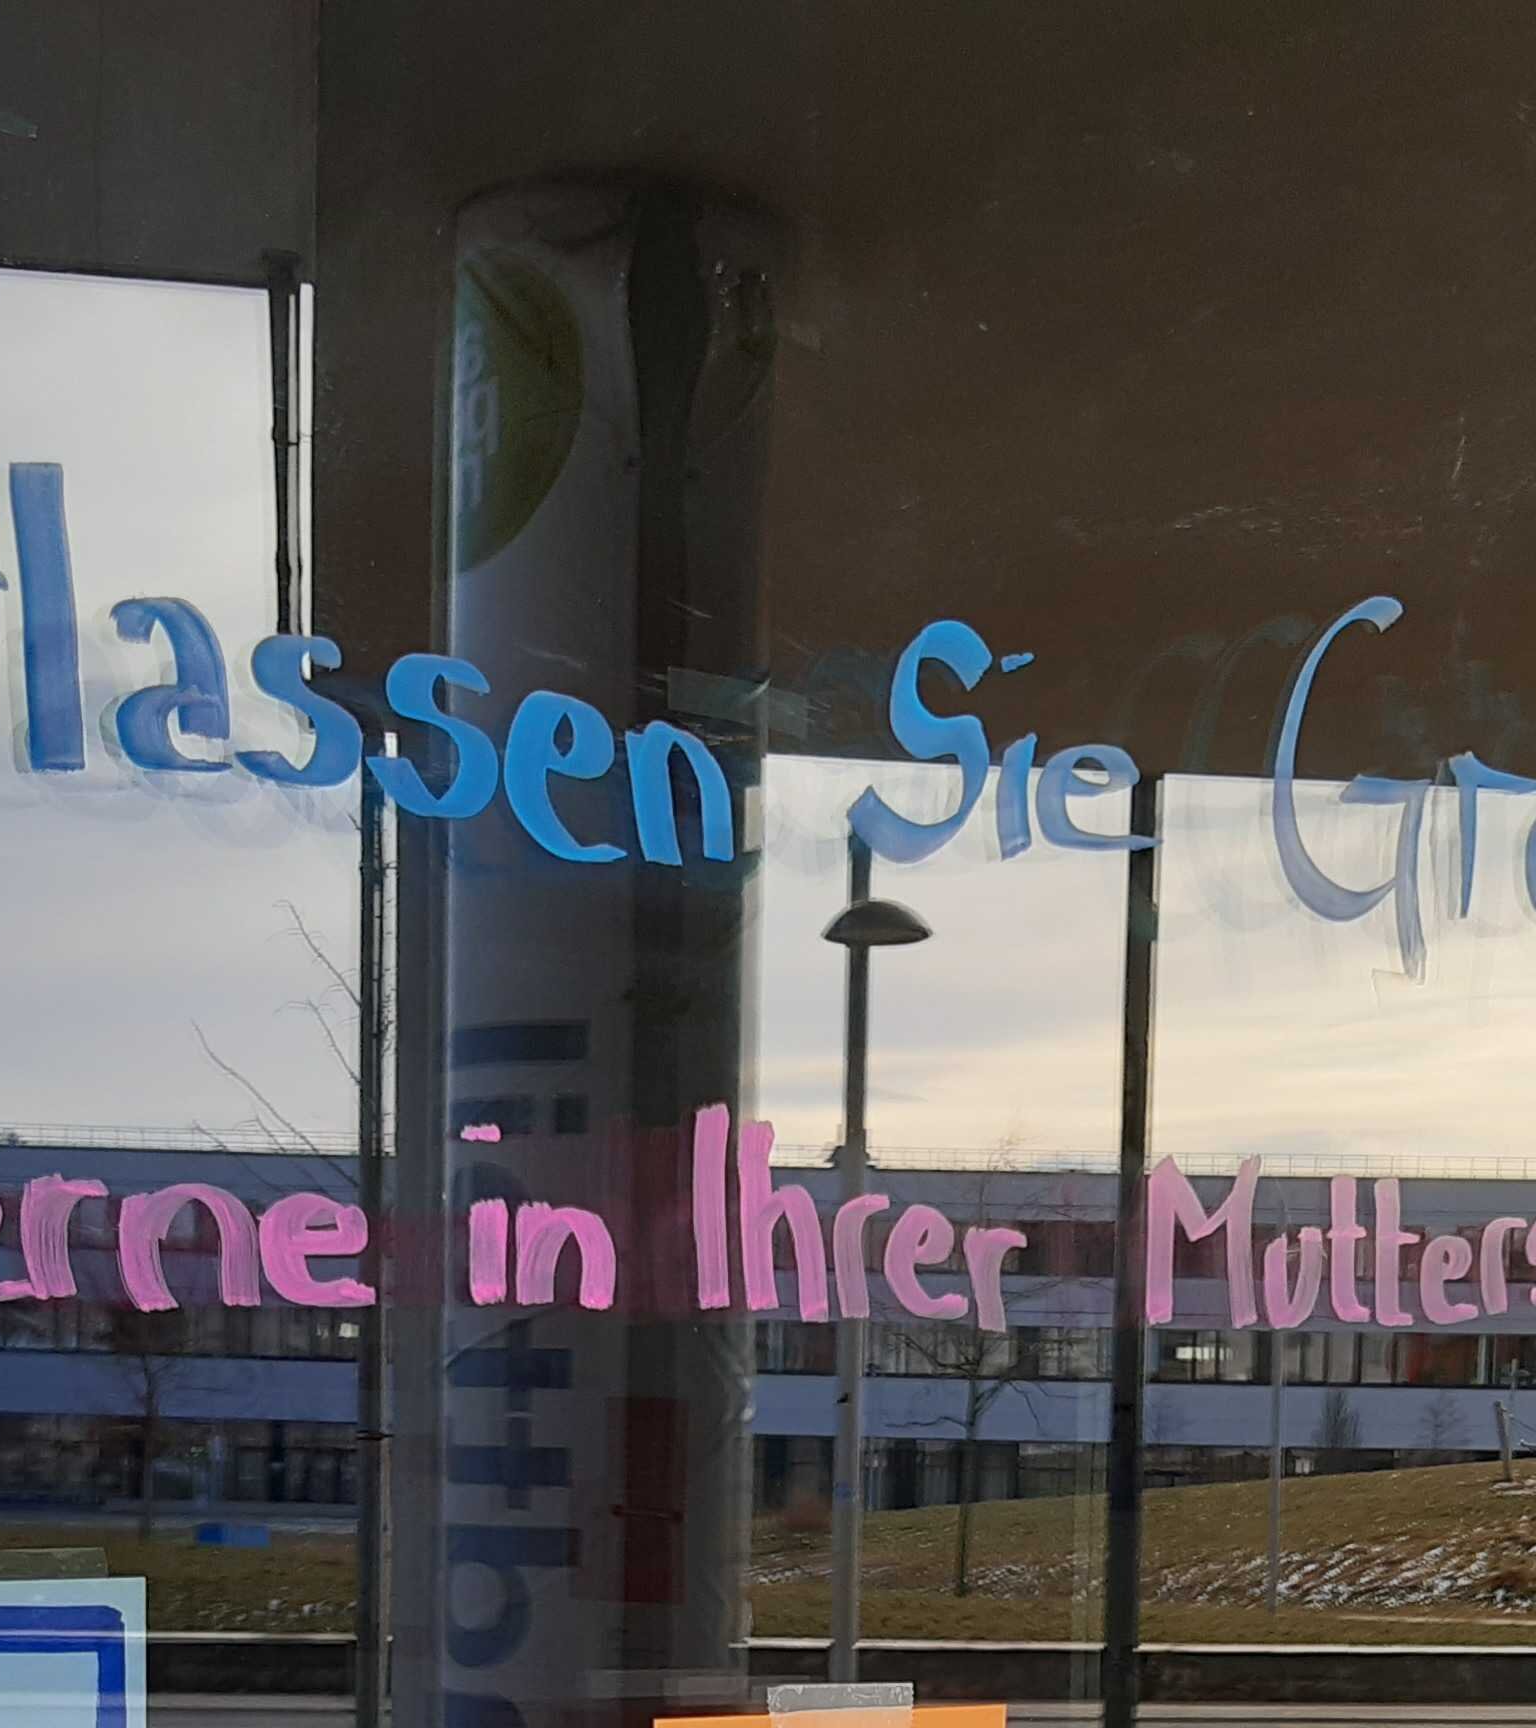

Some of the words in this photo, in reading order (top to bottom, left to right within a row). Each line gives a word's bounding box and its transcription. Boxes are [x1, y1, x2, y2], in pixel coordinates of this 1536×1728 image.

[849, 620, 1158, 863] Sie
[461, 1123, 616, 1309] in
[693, 1103, 1026, 1332] Ihrer
